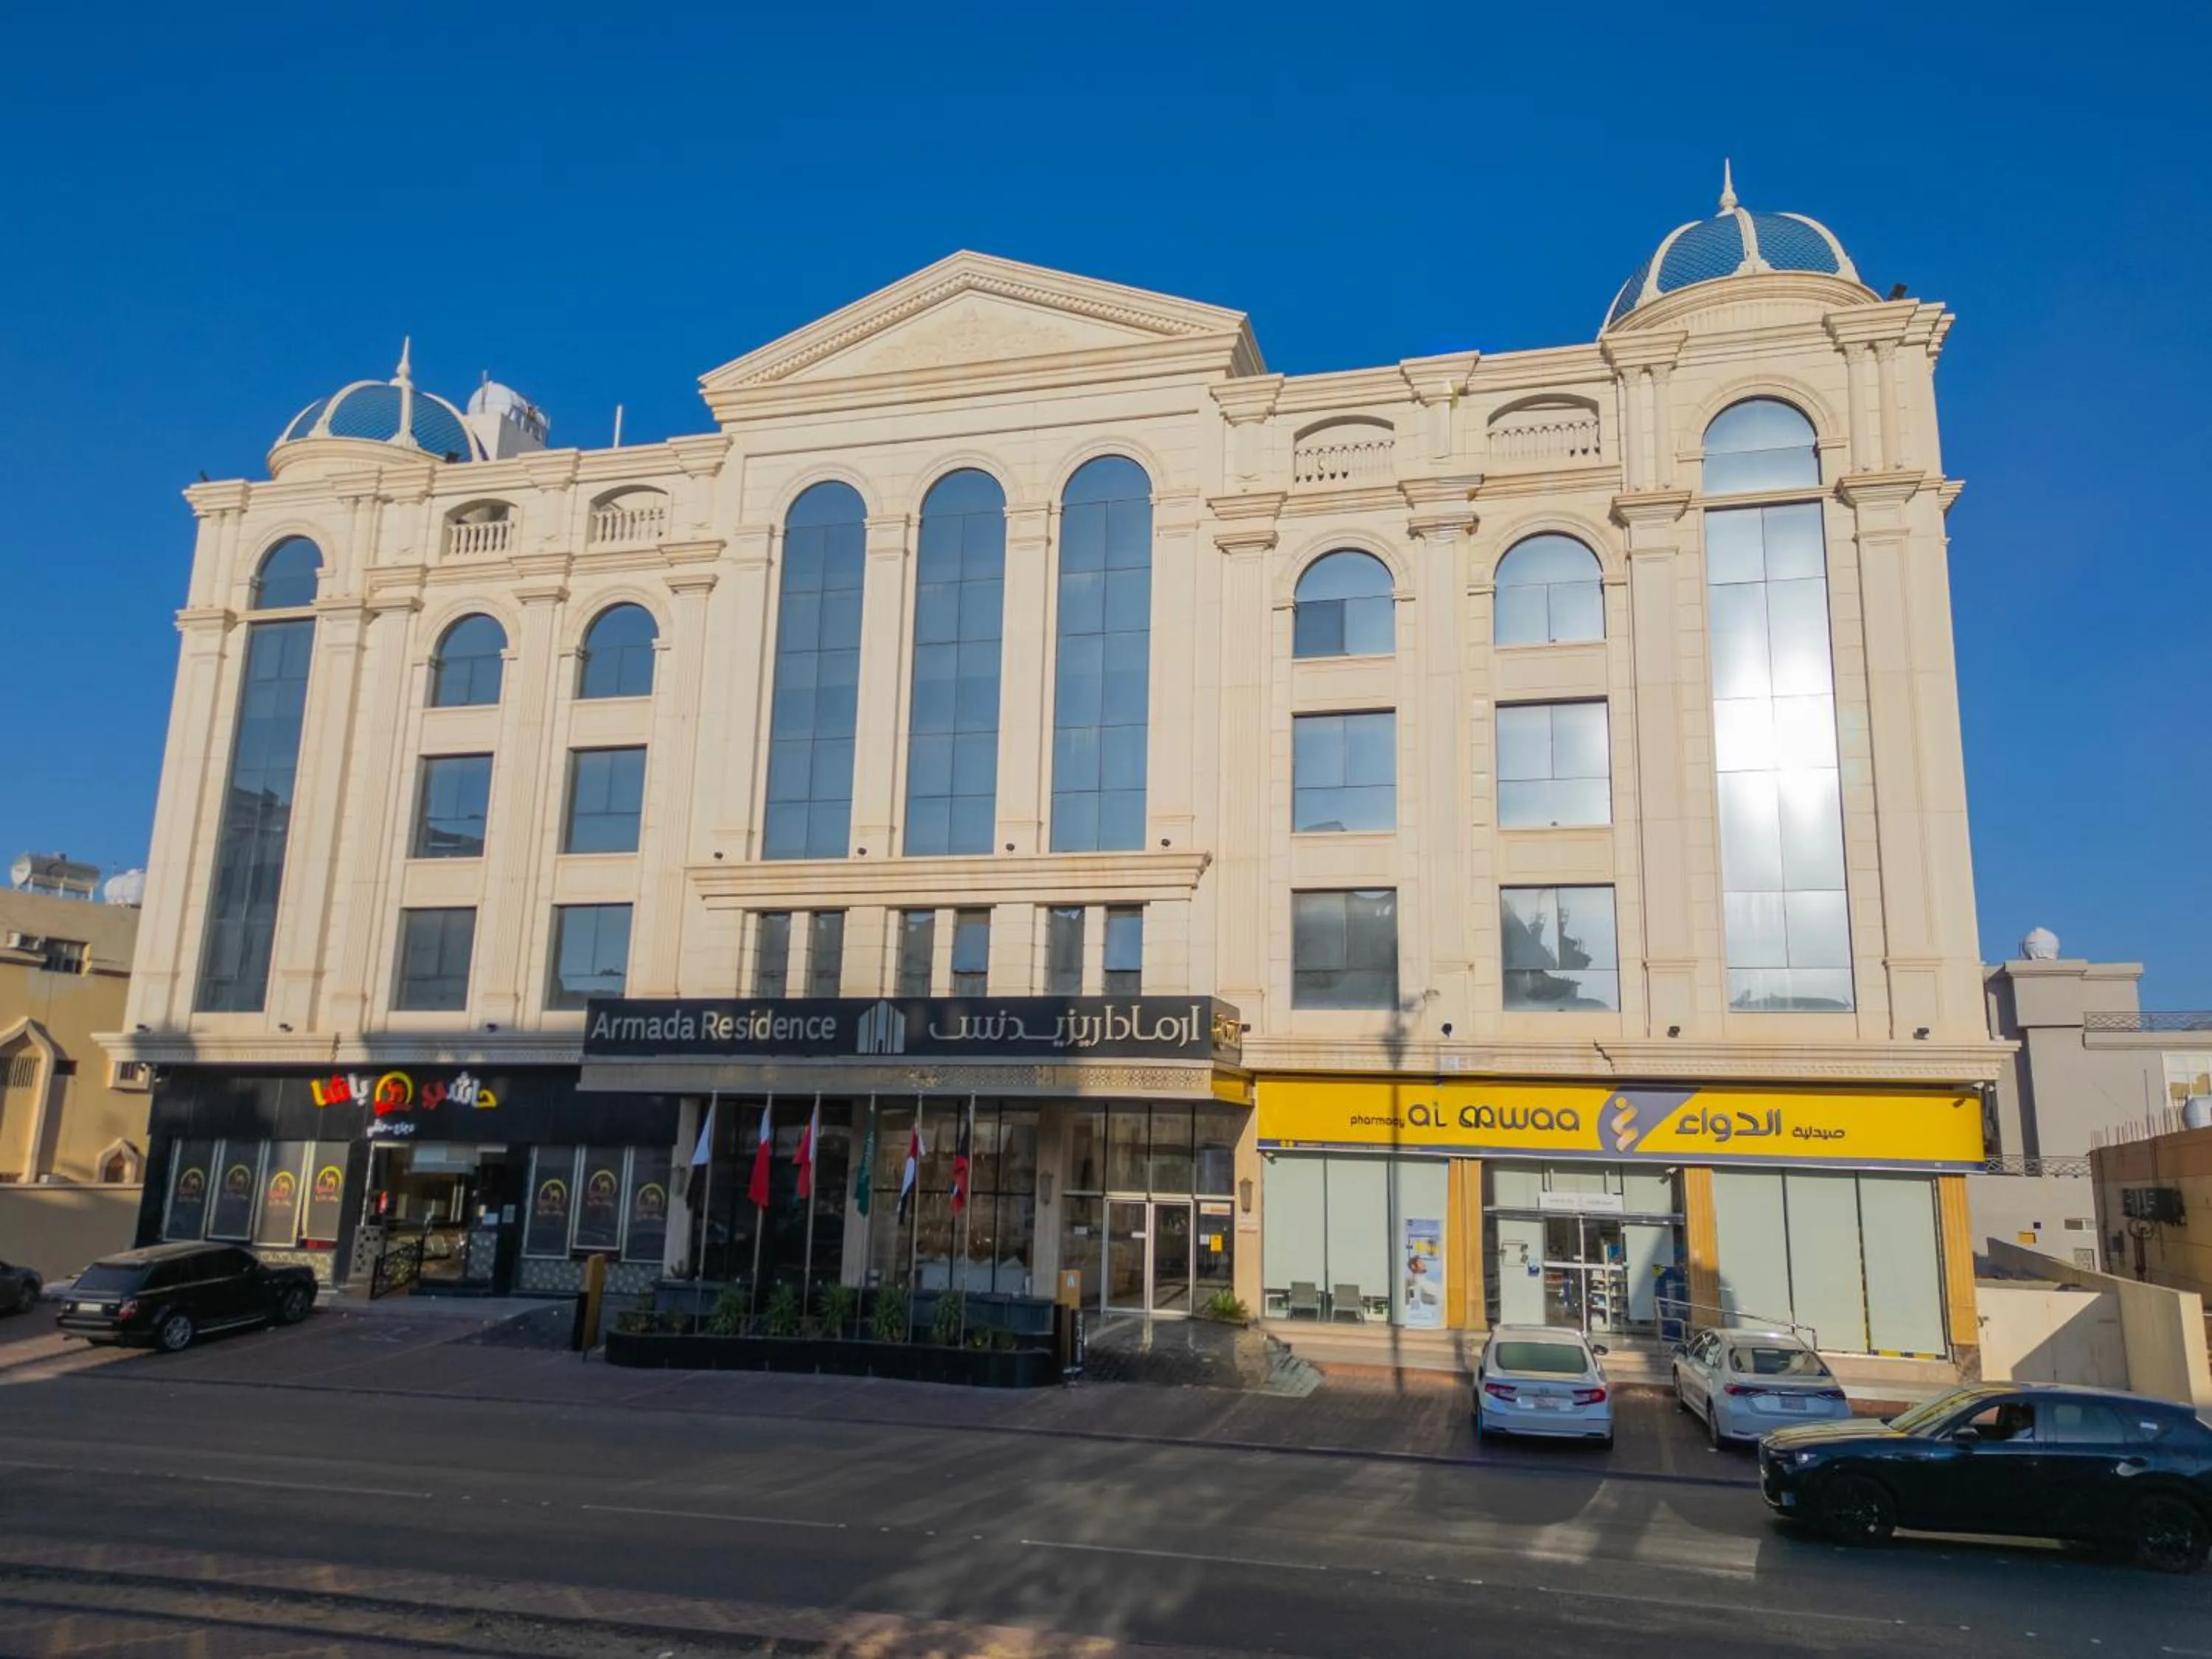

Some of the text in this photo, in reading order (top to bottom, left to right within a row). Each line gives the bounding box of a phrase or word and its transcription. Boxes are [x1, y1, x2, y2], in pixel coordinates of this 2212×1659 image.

[591, 1009, 837, 1041] Armada Residence
[310, 1071, 498, 1110] حاشي باشا
[1349, 1114, 1405, 1129] pharmacy
[1407, 1102, 1447, 1127] al
[1674, 1107, 1782, 1143] الدواء
